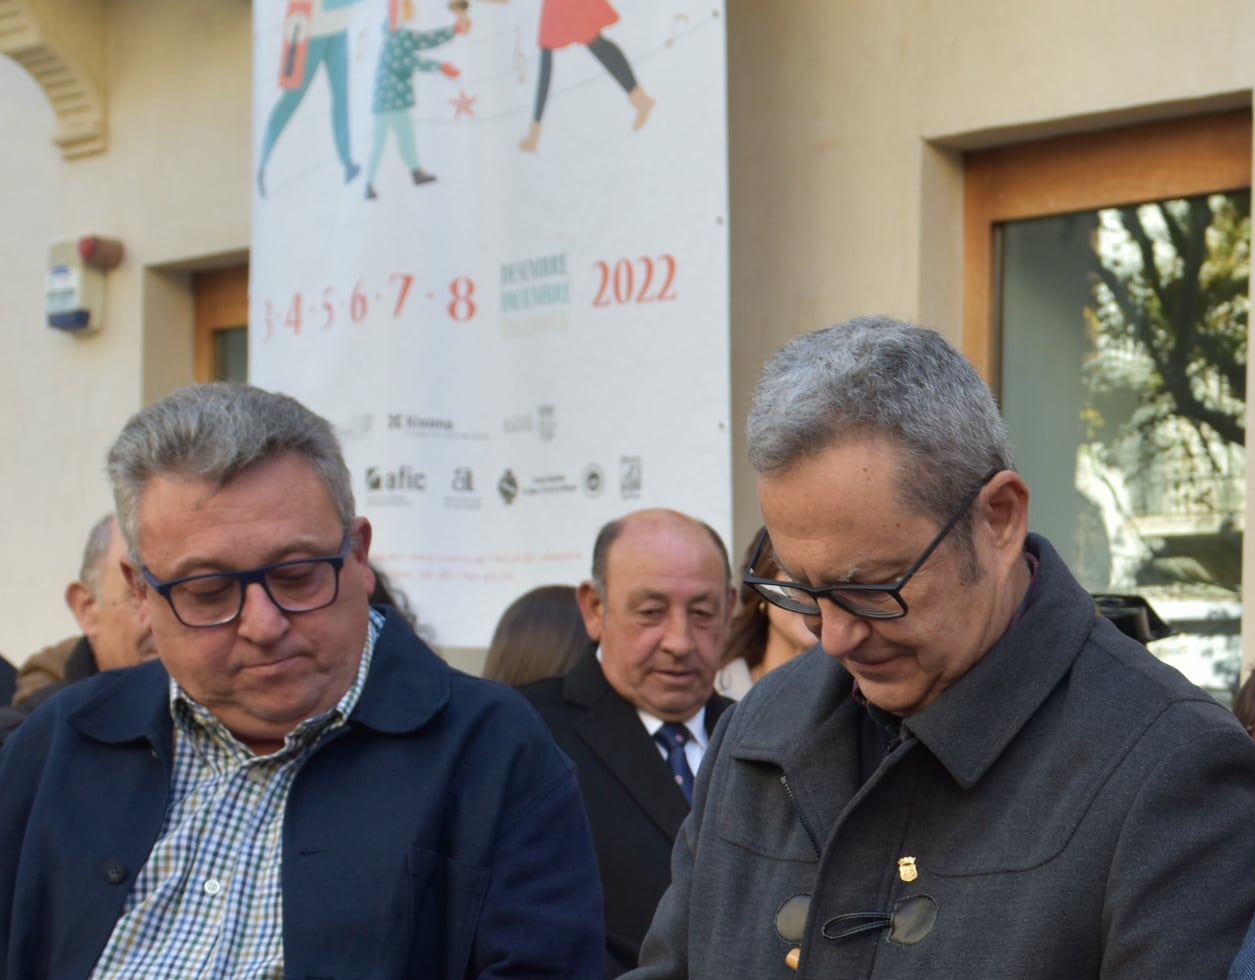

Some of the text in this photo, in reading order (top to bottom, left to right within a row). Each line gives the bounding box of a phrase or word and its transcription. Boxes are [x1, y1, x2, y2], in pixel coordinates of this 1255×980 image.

[284, 291, 303, 336] 4
[350, 277, 369, 325] 6
[388, 272, 416, 320] 7
[447, 276, 478, 323] 8
[592, 253, 679, 308] 2022
[386, 466, 427, 491] afic
